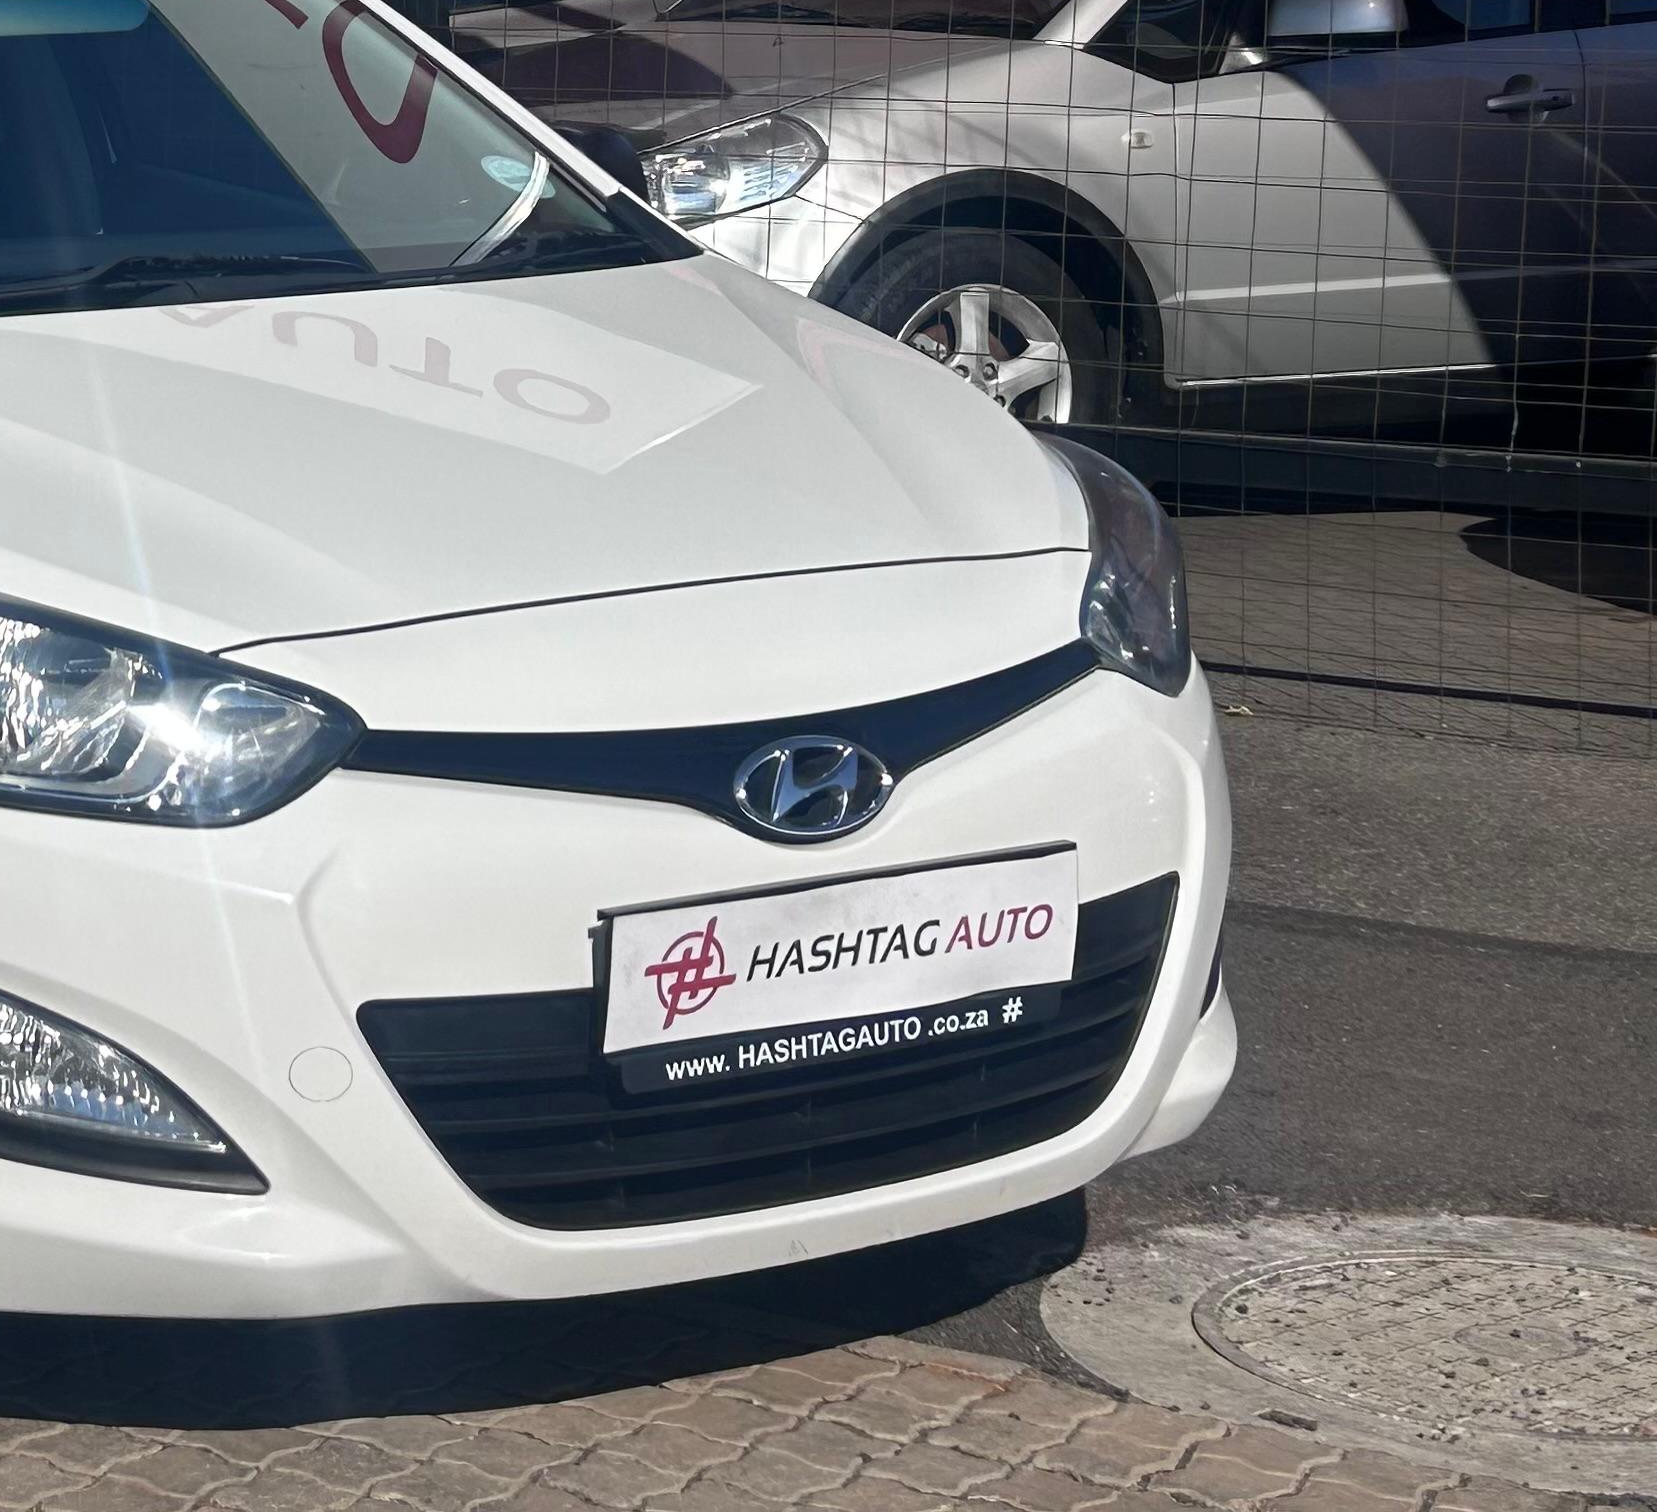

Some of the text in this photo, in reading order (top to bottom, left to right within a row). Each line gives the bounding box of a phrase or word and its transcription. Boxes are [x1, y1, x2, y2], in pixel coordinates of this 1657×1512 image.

[746, 904, 1054, 982] HASHTAG AUTO
[665, 1053, 732, 1081] www.
[738, 1016, 922, 1070] HASHTAGAUTO
[927, 1009, 989, 1038] .co.za
